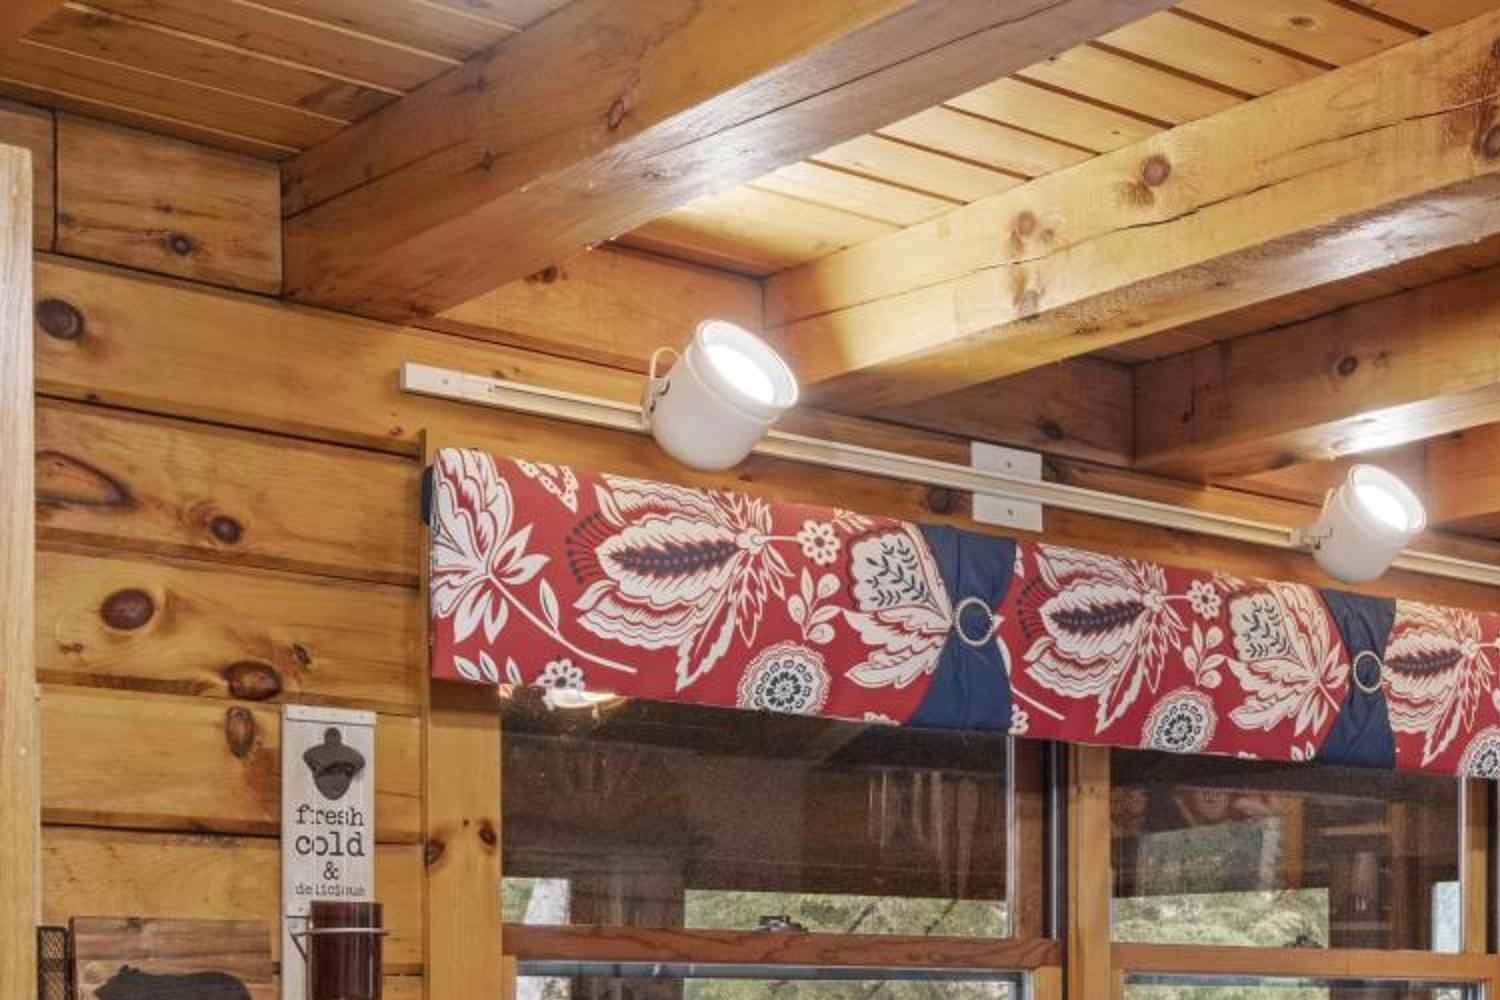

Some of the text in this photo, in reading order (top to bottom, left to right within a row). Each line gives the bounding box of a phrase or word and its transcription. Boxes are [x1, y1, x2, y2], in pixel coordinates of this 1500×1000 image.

[295, 804, 364, 827] fresh
[295, 831, 365, 857] cold
[323, 860, 340, 881] &
